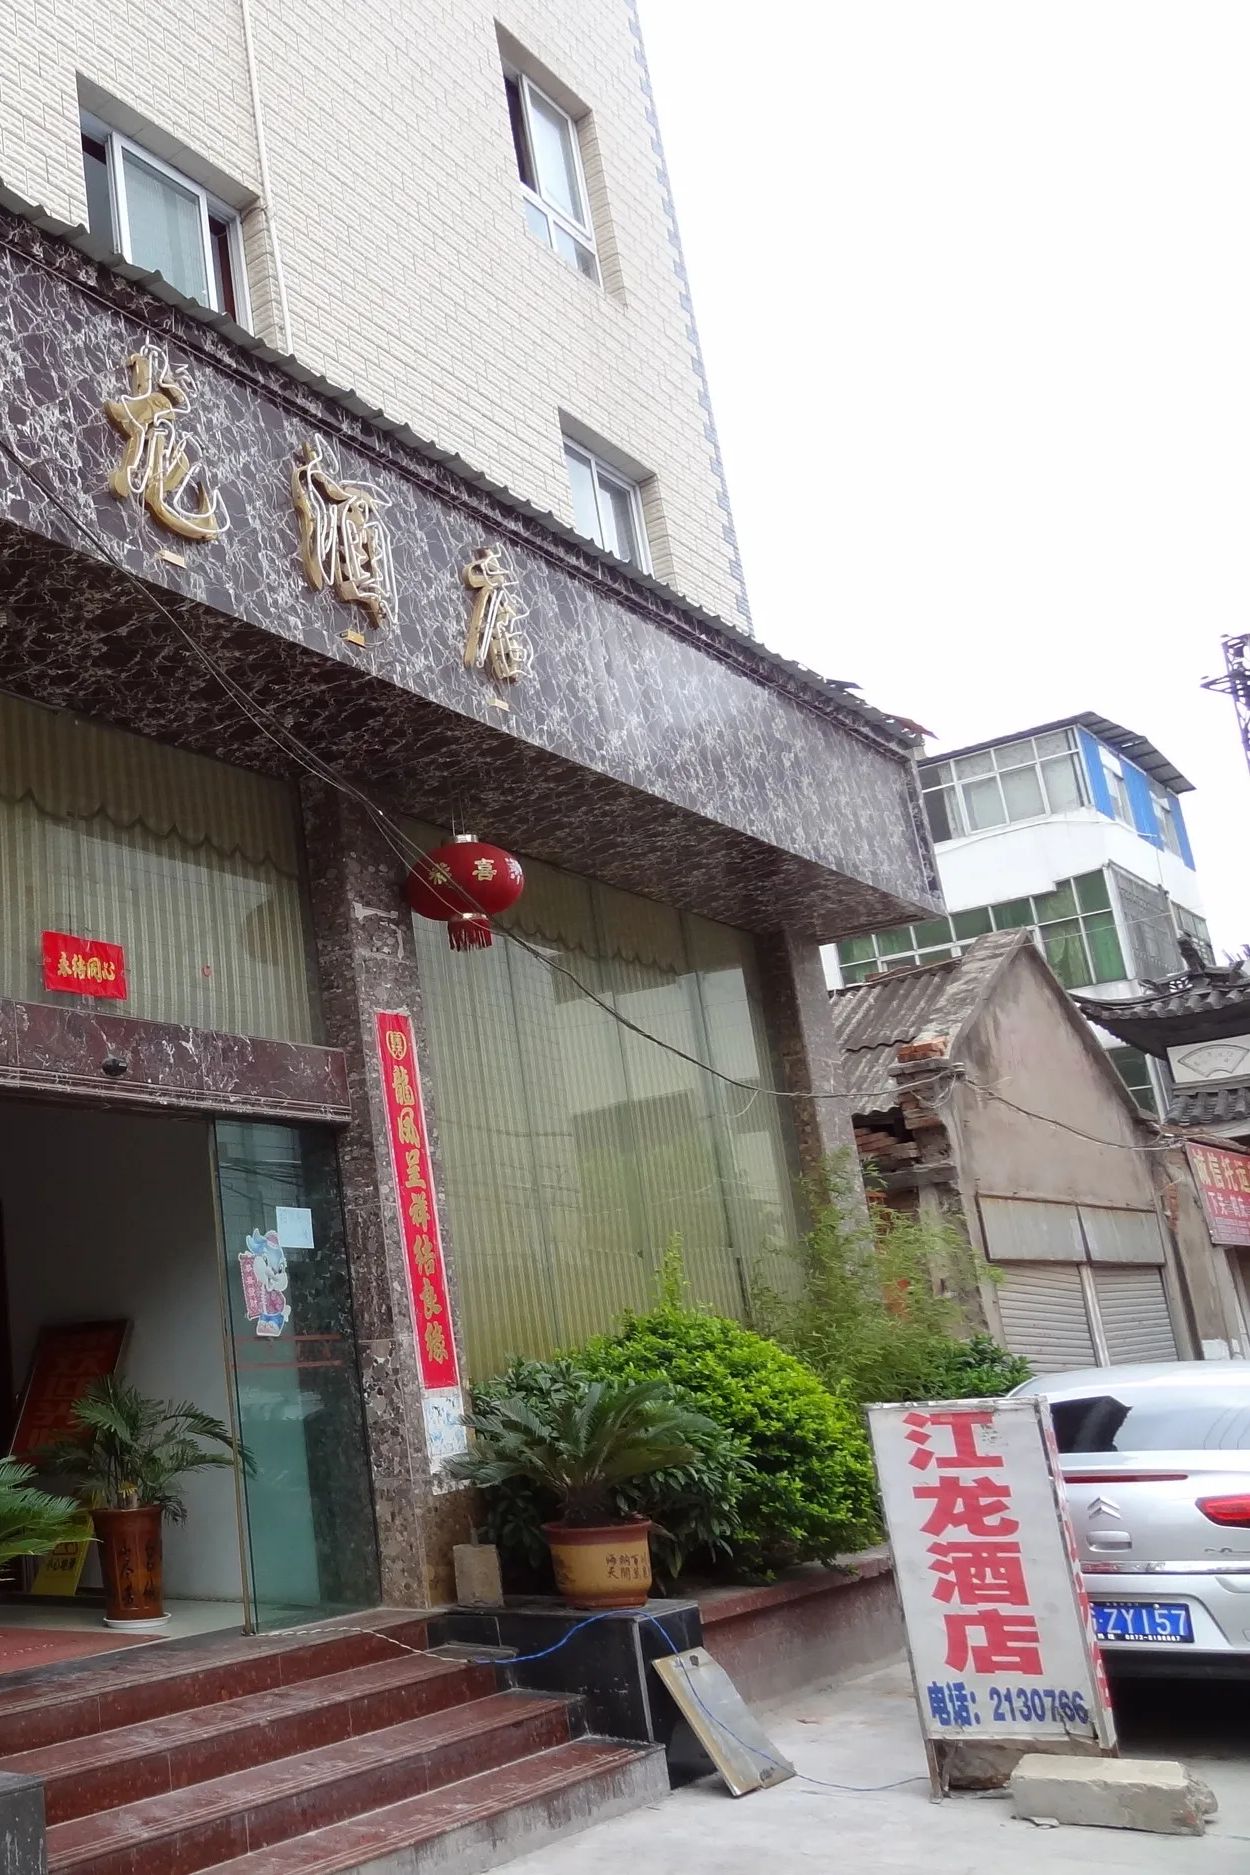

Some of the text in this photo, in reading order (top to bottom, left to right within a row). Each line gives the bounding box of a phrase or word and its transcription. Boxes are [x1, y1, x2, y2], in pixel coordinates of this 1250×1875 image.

[902, 1410, 1044, 1676] 江龙酒店
[989, 1687, 1089, 1724] 2130766
